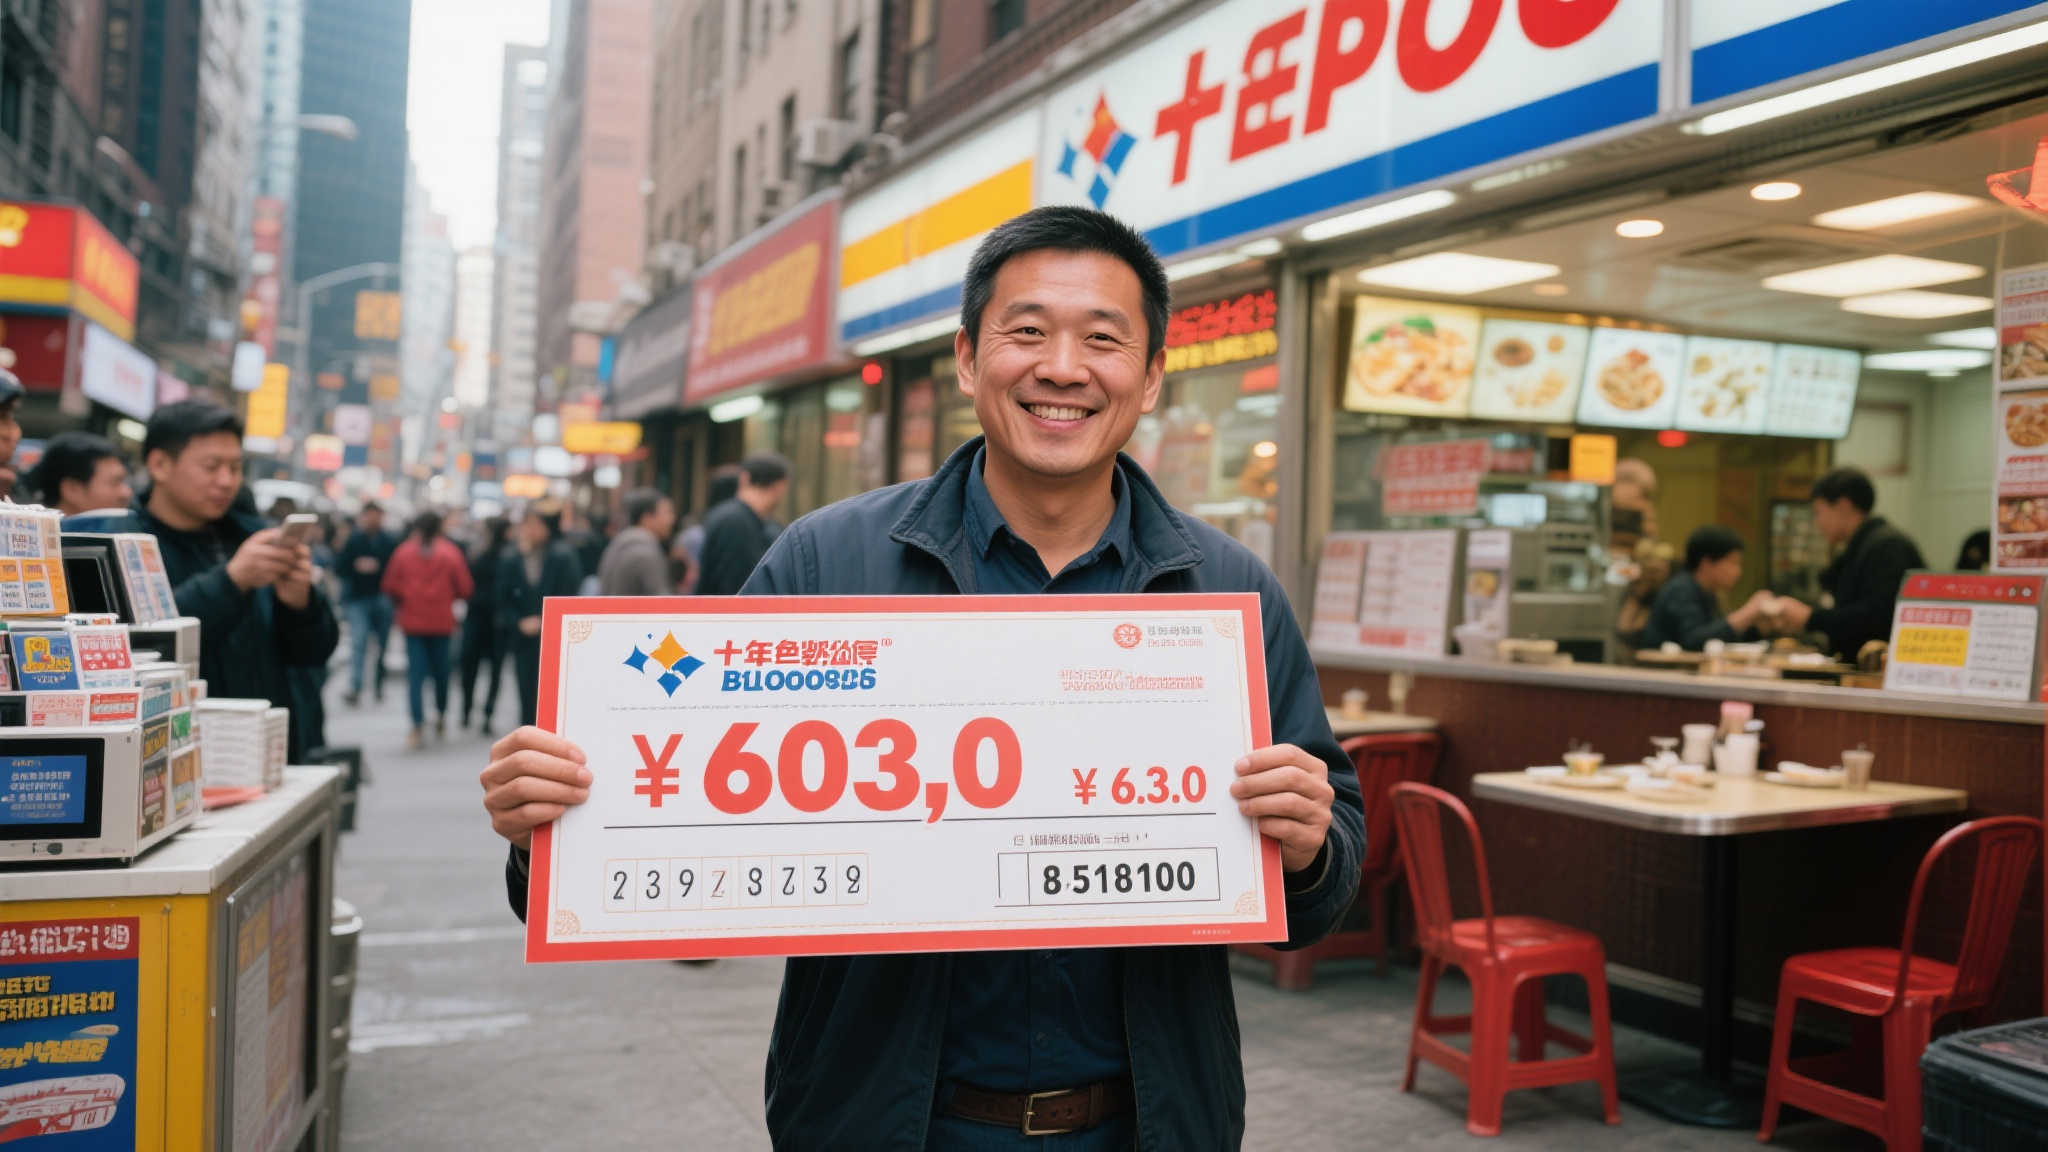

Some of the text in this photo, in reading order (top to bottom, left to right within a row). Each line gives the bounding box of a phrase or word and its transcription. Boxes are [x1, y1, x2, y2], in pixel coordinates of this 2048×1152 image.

[631, 717, 1023, 825] ¥ 603,0
[1110, 765, 1207, 805] 6.3.0
